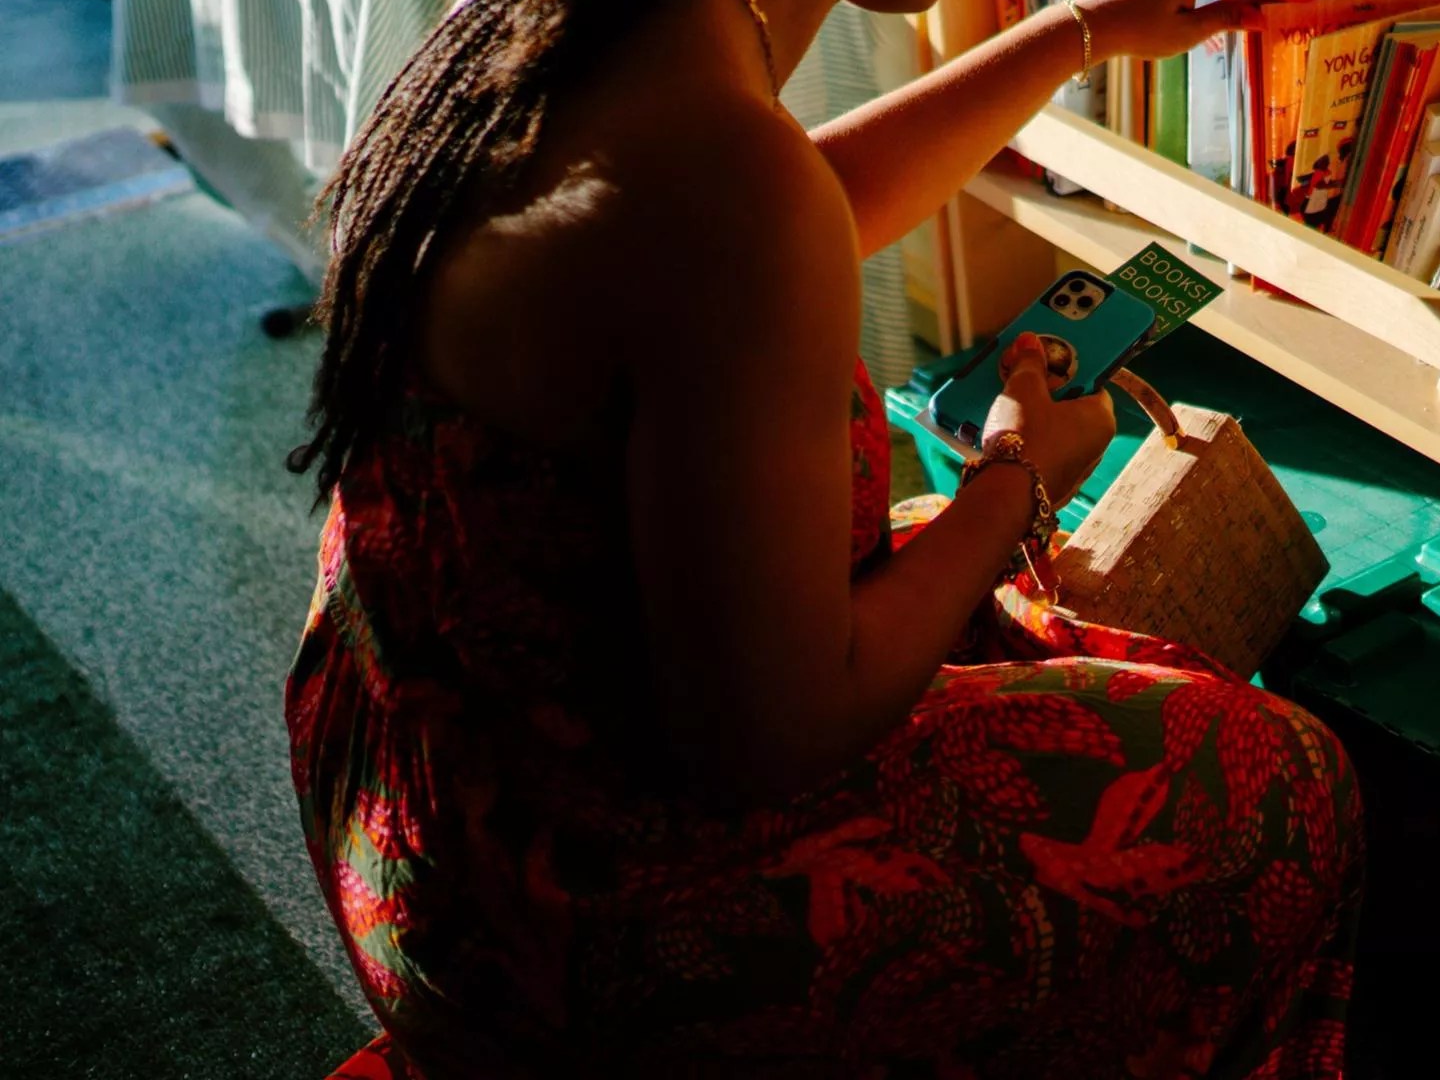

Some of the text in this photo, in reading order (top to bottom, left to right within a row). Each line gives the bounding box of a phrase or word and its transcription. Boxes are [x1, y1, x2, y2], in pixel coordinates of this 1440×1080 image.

[1324, 51, 1356, 74] YON
[1119, 266, 1191, 318] BOOKS!
[1139, 250, 1212, 302] BOOKS!
